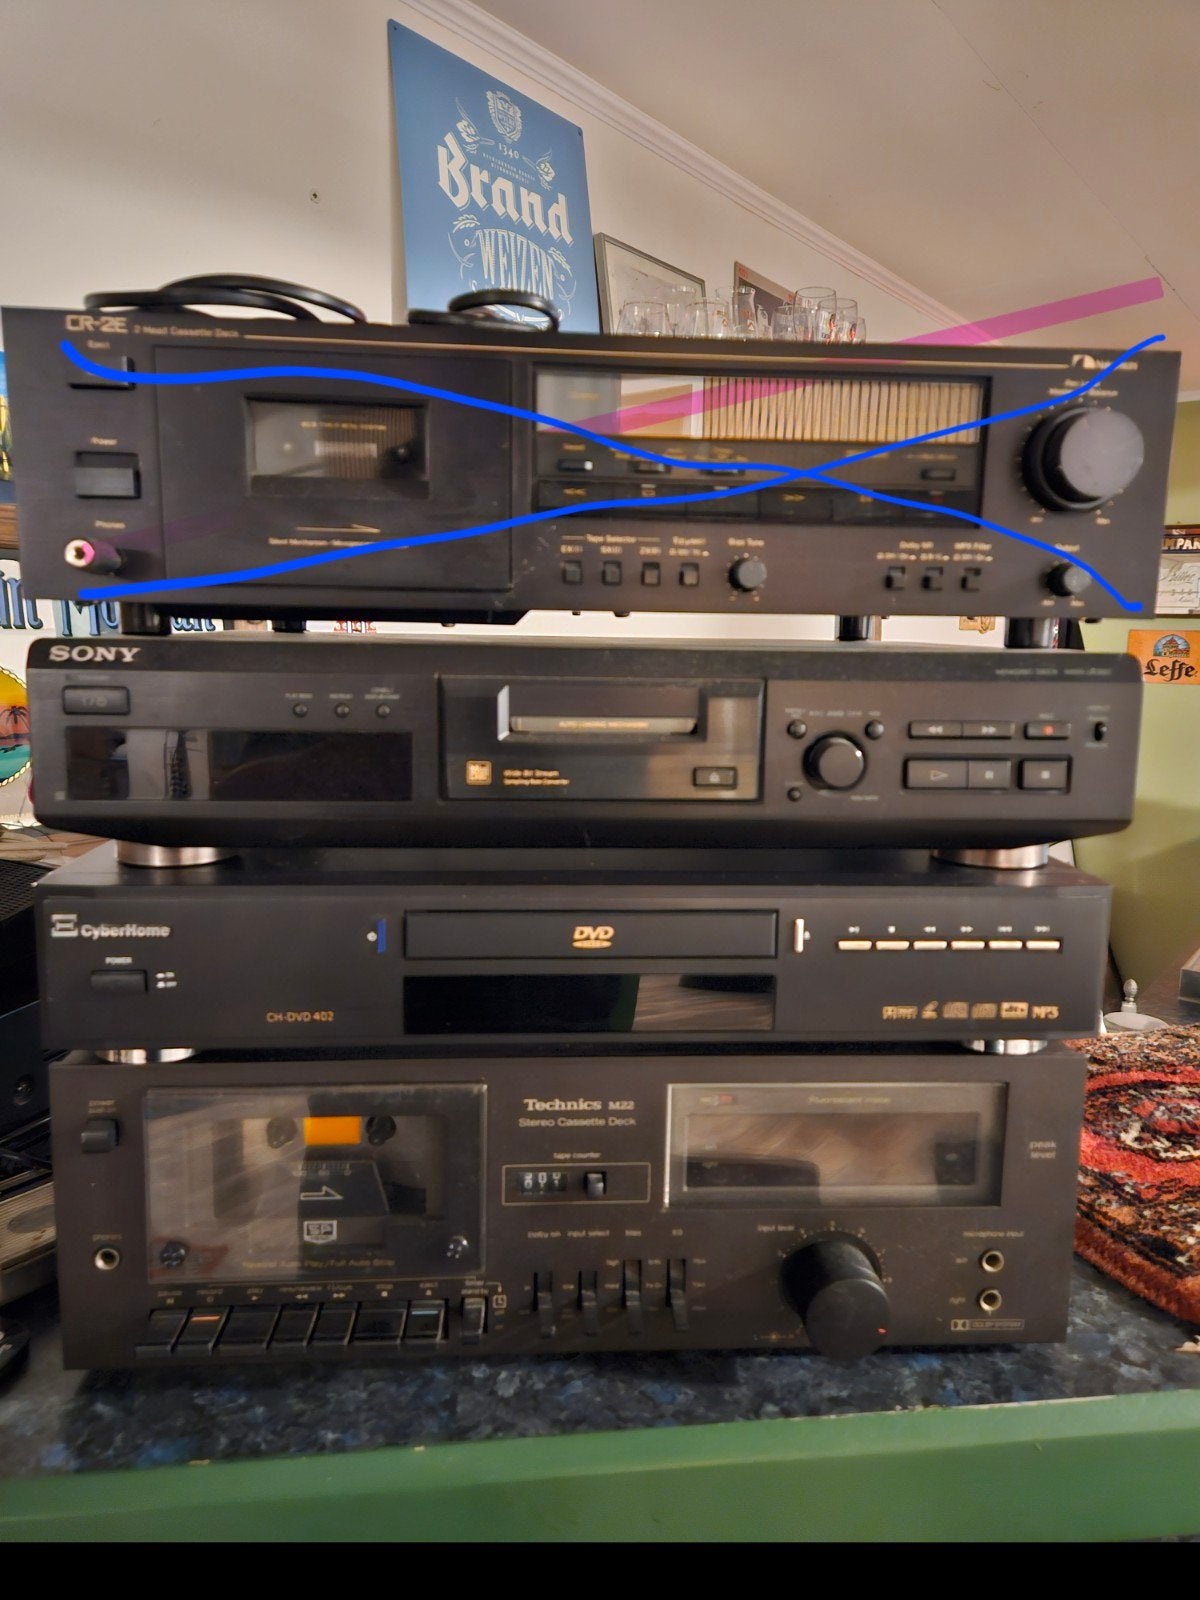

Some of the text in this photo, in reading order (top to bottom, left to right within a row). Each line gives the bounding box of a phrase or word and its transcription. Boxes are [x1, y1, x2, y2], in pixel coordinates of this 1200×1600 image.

[499, 142, 520, 159] 1340
[436, 132, 575, 247] Brand
[475, 228, 554, 300] WEIZEN
[66, 314, 128, 334] CR-2E
[49, 645, 141, 662] SONY
[1144, 658, 1195, 682] Leffe
[80, 923, 171, 940] CyberHome
[573, 926, 615, 941] DVD
[266, 1010, 335, 1022] CH-DVD 402
[523, 1098, 636, 1111] Technics M22
[518, 1116, 637, 1128] Stereo Cassette Deck
